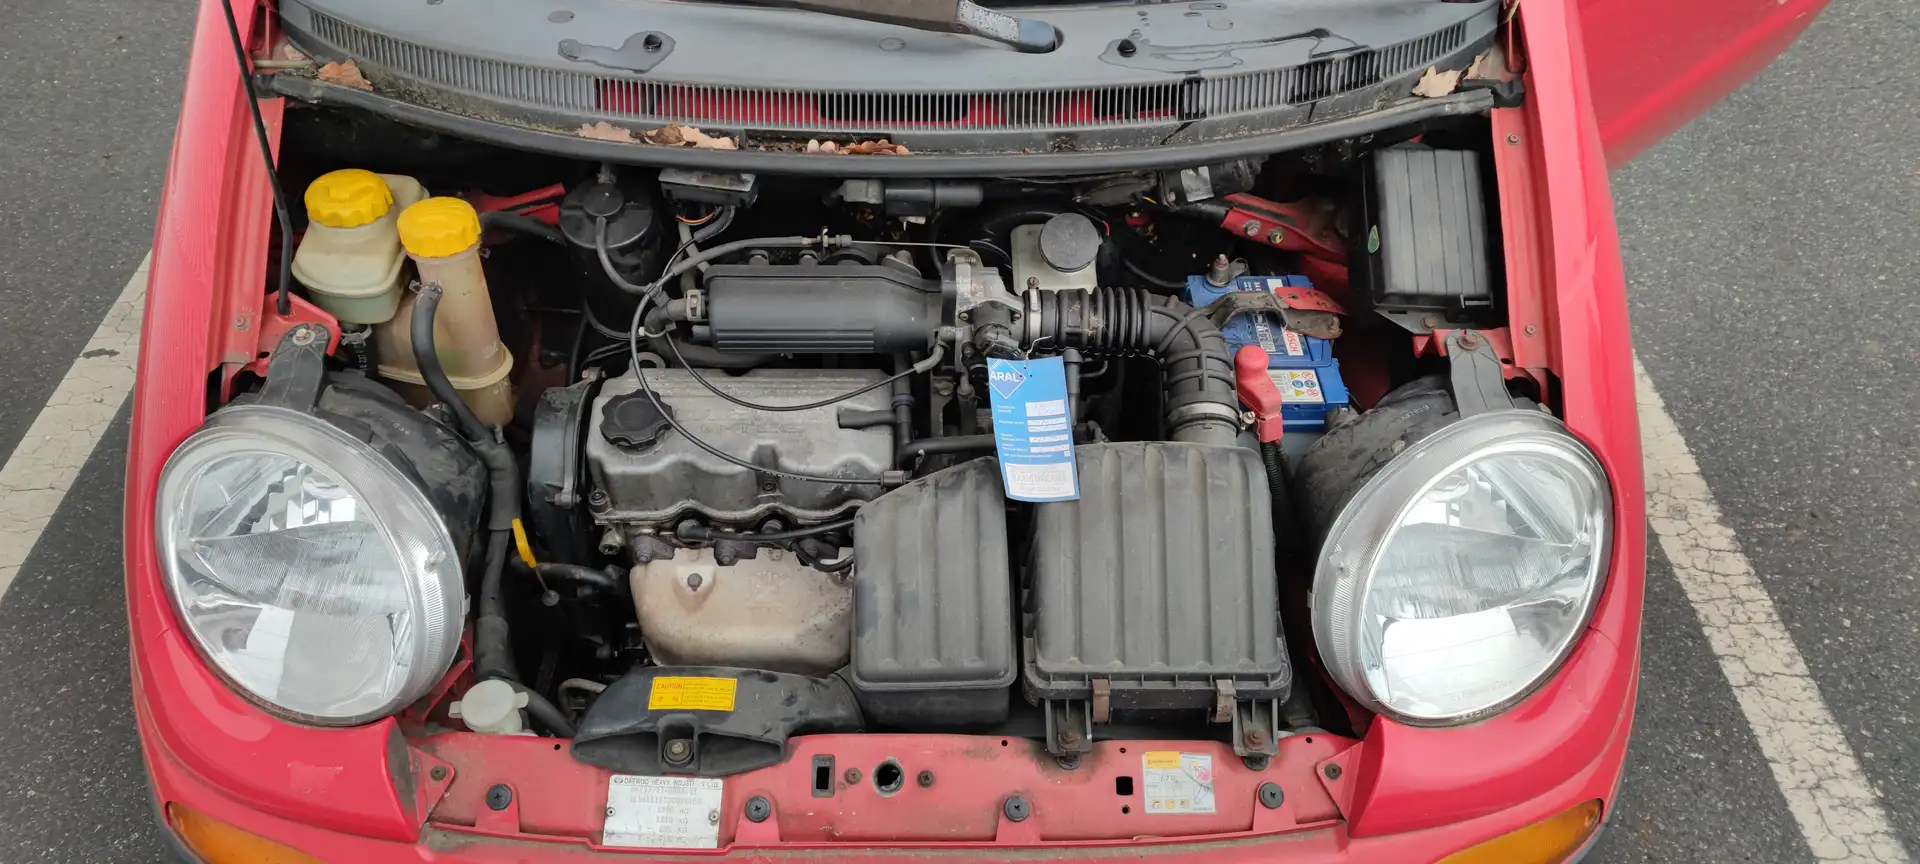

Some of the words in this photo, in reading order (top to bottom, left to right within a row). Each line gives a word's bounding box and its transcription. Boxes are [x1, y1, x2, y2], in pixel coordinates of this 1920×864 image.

[989, 369, 1020, 383] ARAL
[624, 777, 650, 785] DAEWOO
[651, 778, 671, 786] HEAVY
